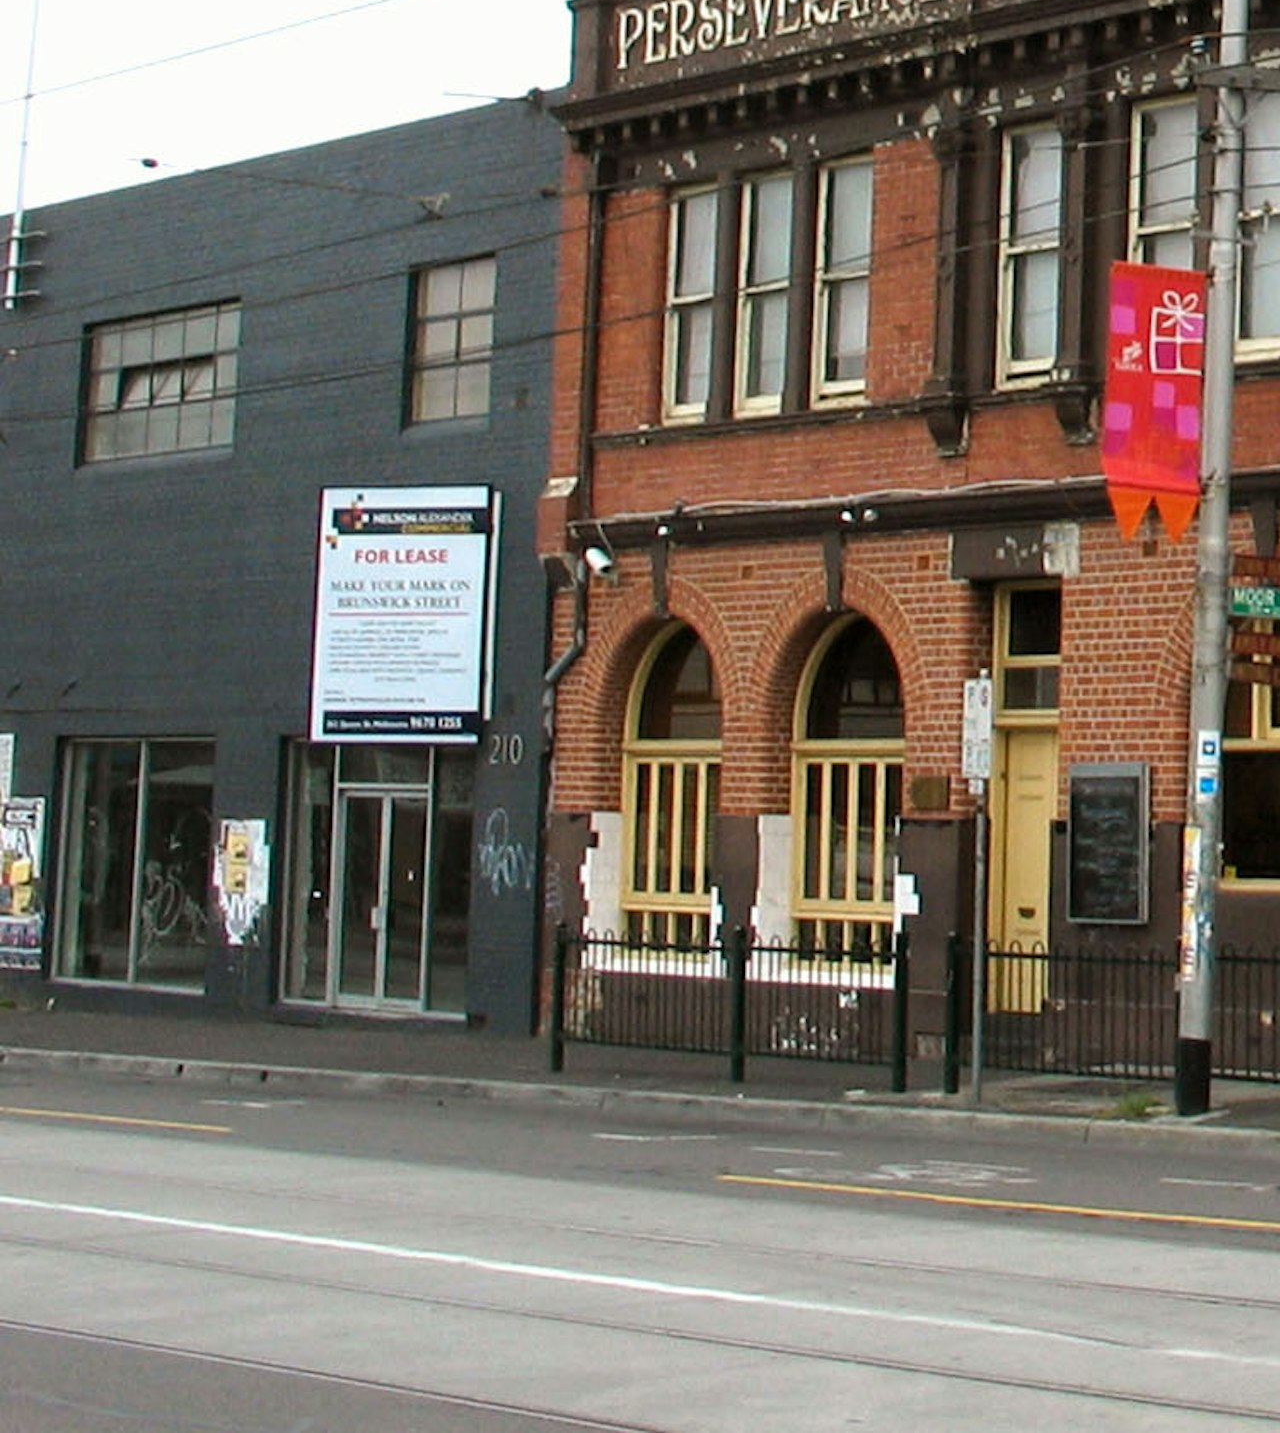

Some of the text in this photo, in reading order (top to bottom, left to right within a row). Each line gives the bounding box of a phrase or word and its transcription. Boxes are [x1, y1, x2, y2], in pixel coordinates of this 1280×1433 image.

[354, 548, 449, 564] FOR LEASE
[331, 580, 471, 592] MAKE YOUR MARK ON
[337, 596, 462, 609] BRUNSWICK STREET
[1232, 587, 1276, 607] MOOR
[489, 734, 524, 765] 210
